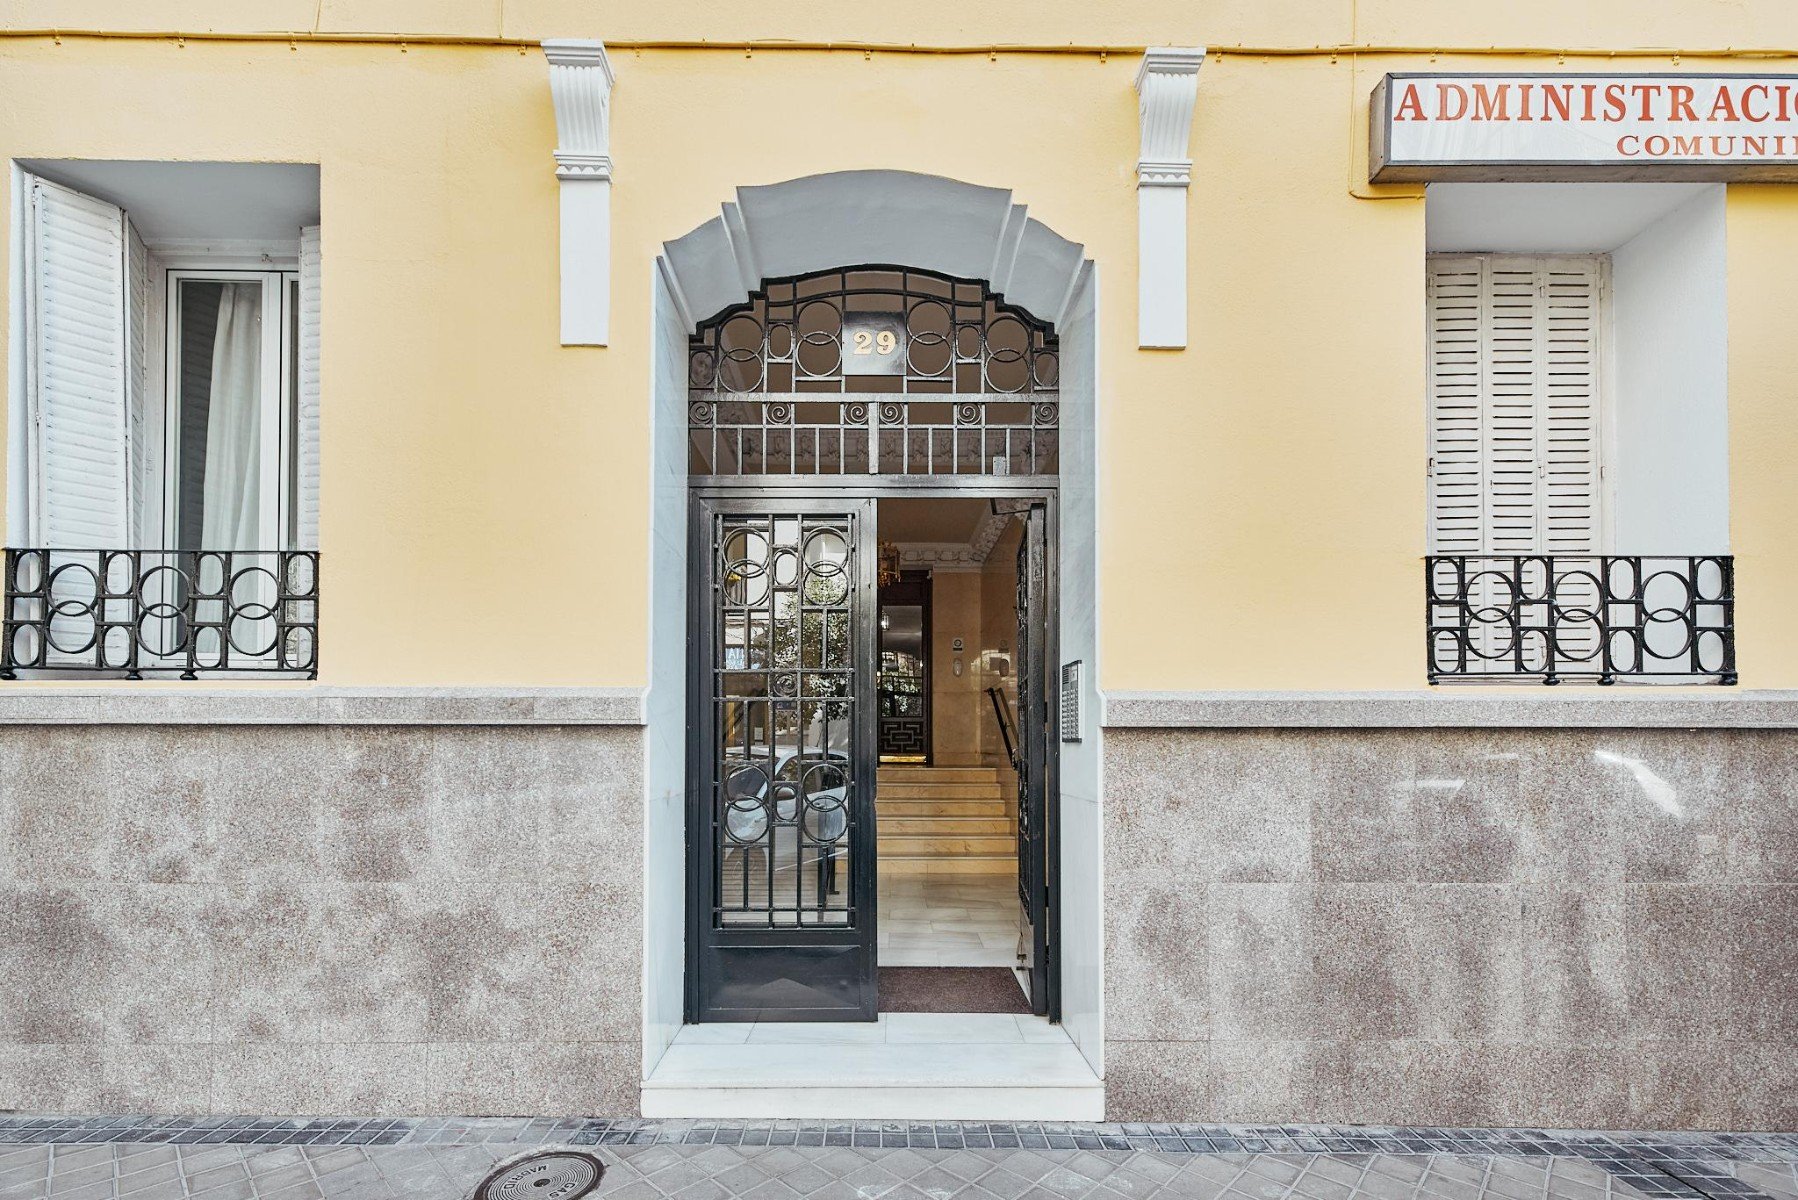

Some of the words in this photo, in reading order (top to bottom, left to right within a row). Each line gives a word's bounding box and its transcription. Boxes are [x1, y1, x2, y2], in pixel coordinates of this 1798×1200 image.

[1393, 83, 1798, 122] ADMINISTRACI
[853, 330, 896, 355] 29
[503, 1165, 547, 1189] MADRID
[549, 1182, 576, 1198] GAS
